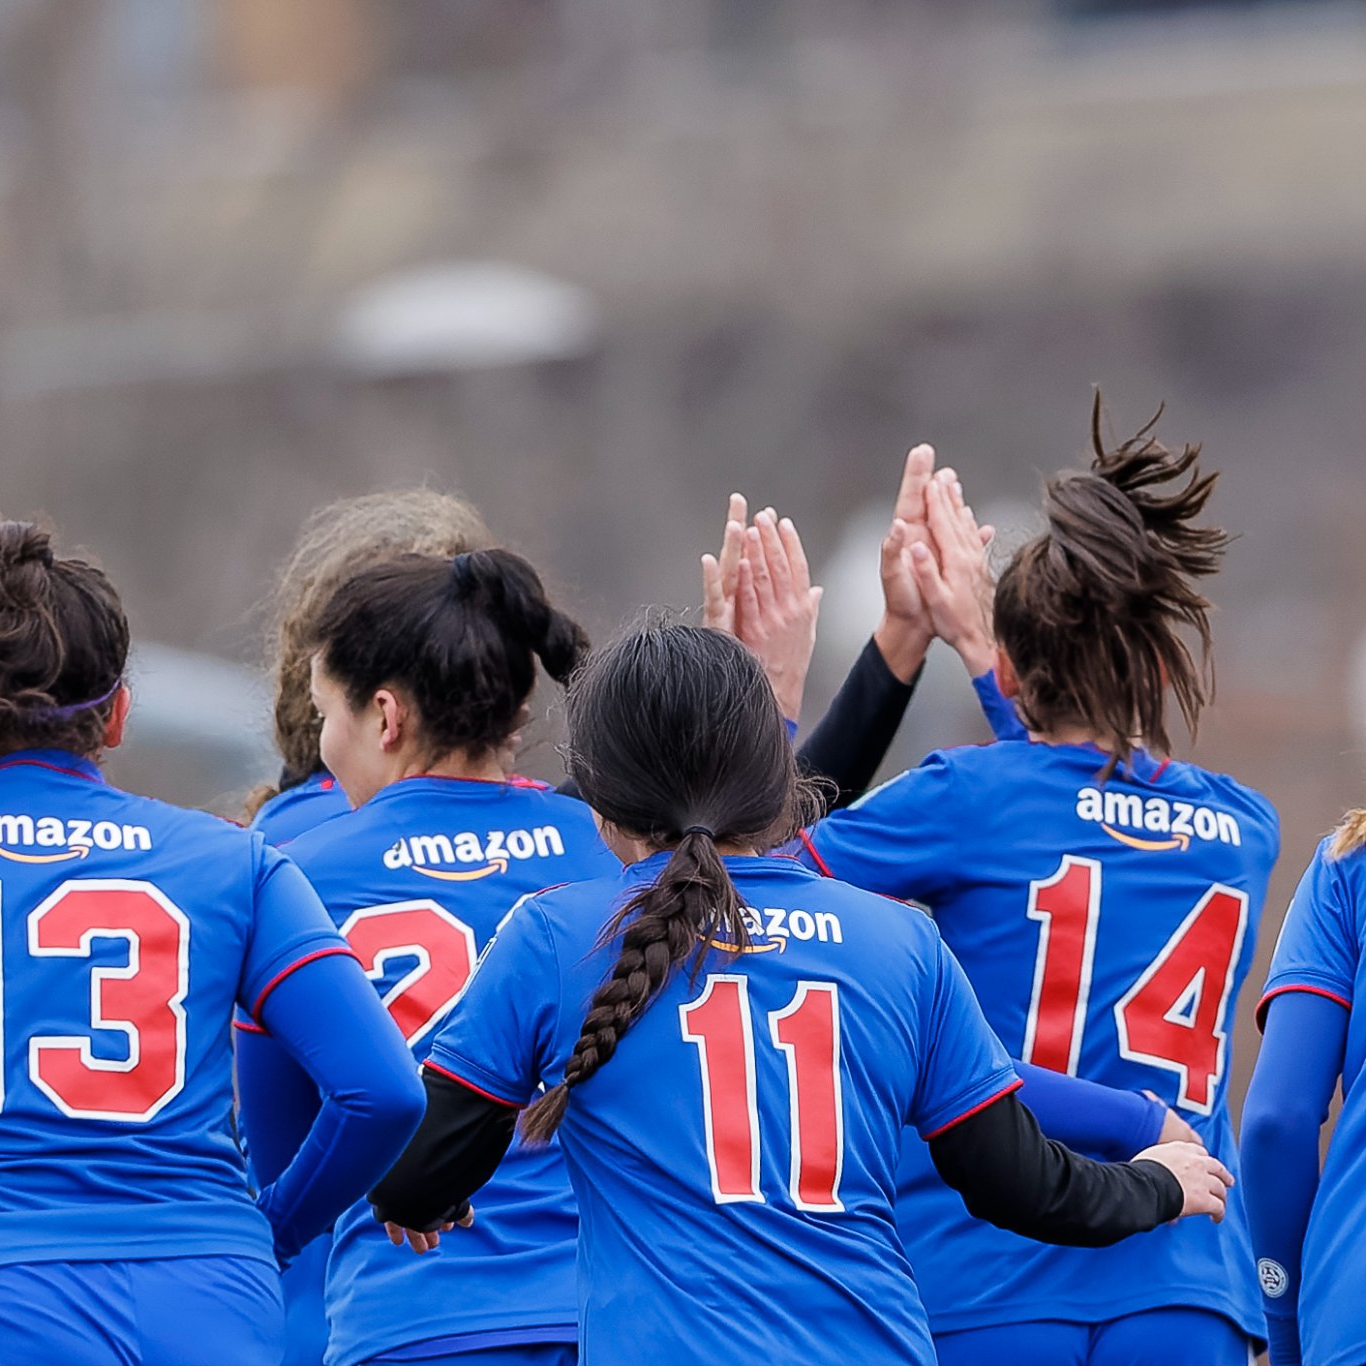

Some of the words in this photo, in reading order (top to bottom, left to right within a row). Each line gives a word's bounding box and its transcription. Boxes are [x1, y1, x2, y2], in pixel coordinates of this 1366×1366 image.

[383, 825, 566, 870] amazon
[1076, 787, 1242, 847] amazon
[1022, 854, 1249, 1116] 14
[679, 973, 845, 1213] 11
